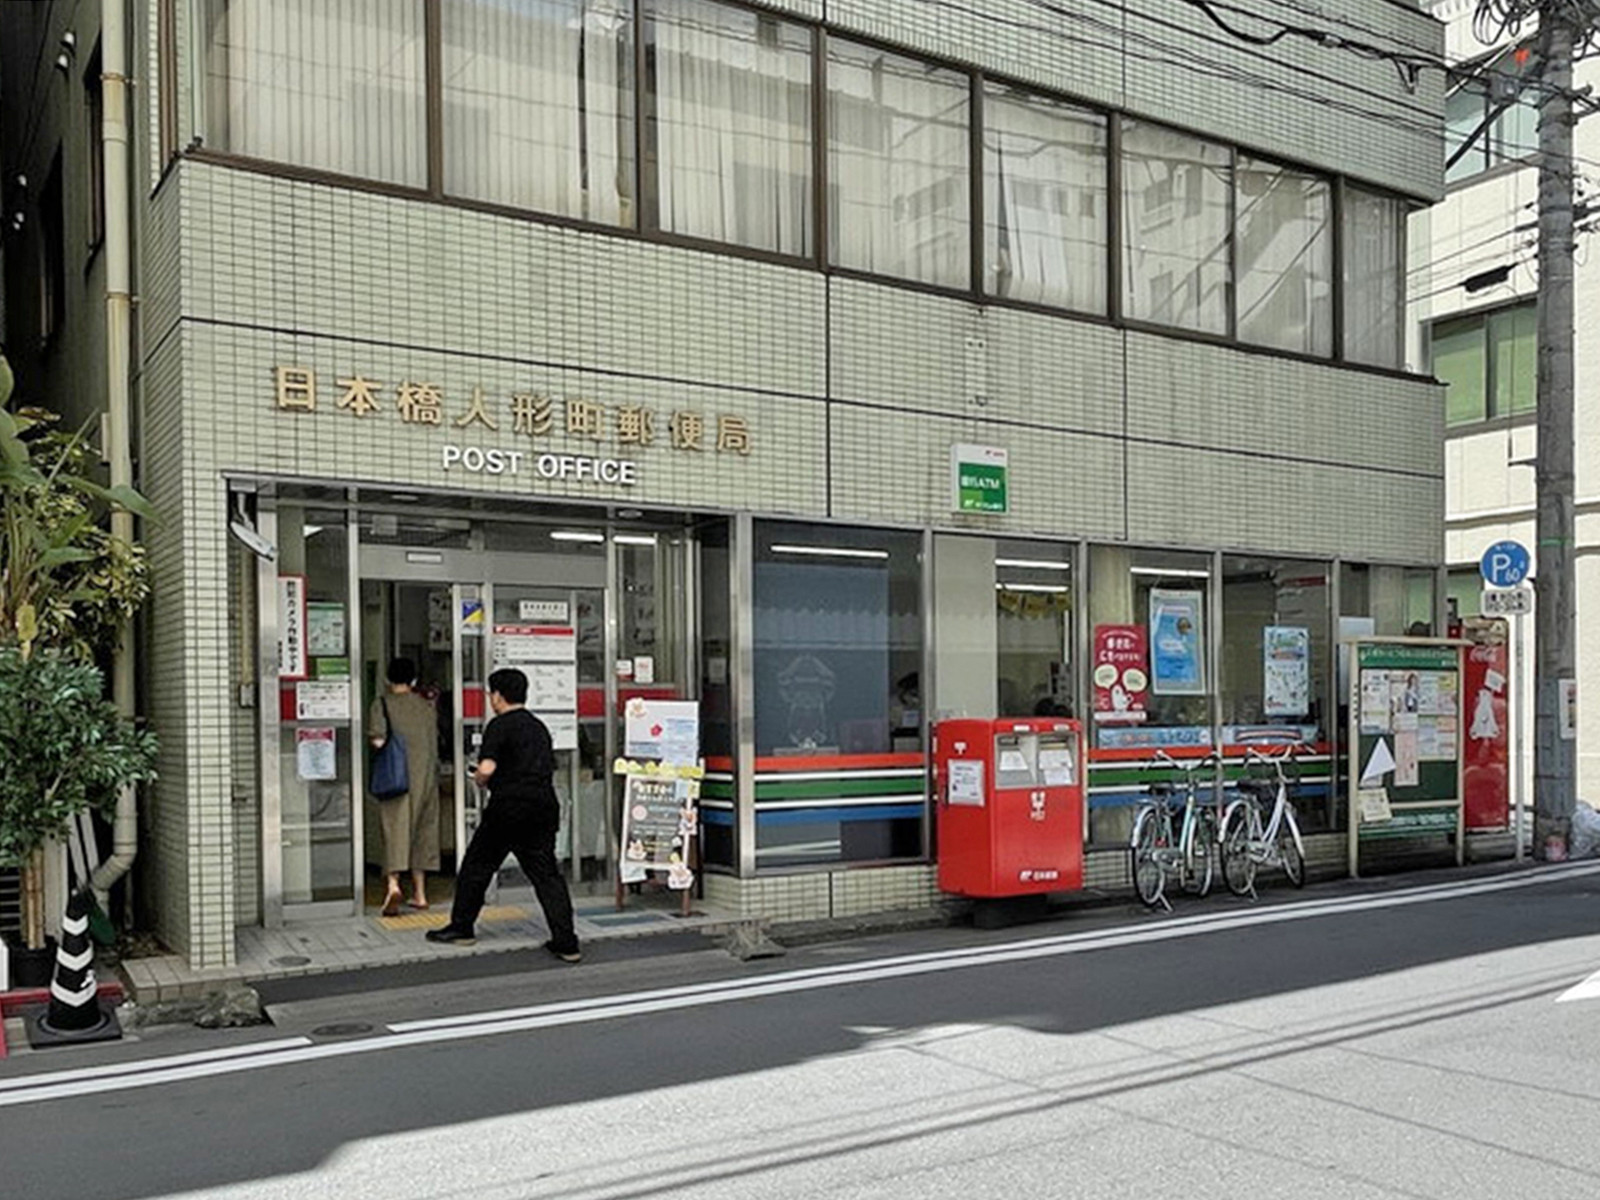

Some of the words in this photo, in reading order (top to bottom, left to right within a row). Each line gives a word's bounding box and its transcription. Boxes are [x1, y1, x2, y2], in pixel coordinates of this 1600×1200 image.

[273, 366, 752, 456] 日本橋人形町郵便局
[442, 446, 522, 476] POST
[538, 454, 636, 486] OFFICE
[1492, 553, 1511, 583] P
[1505, 567, 1521, 583] 60
